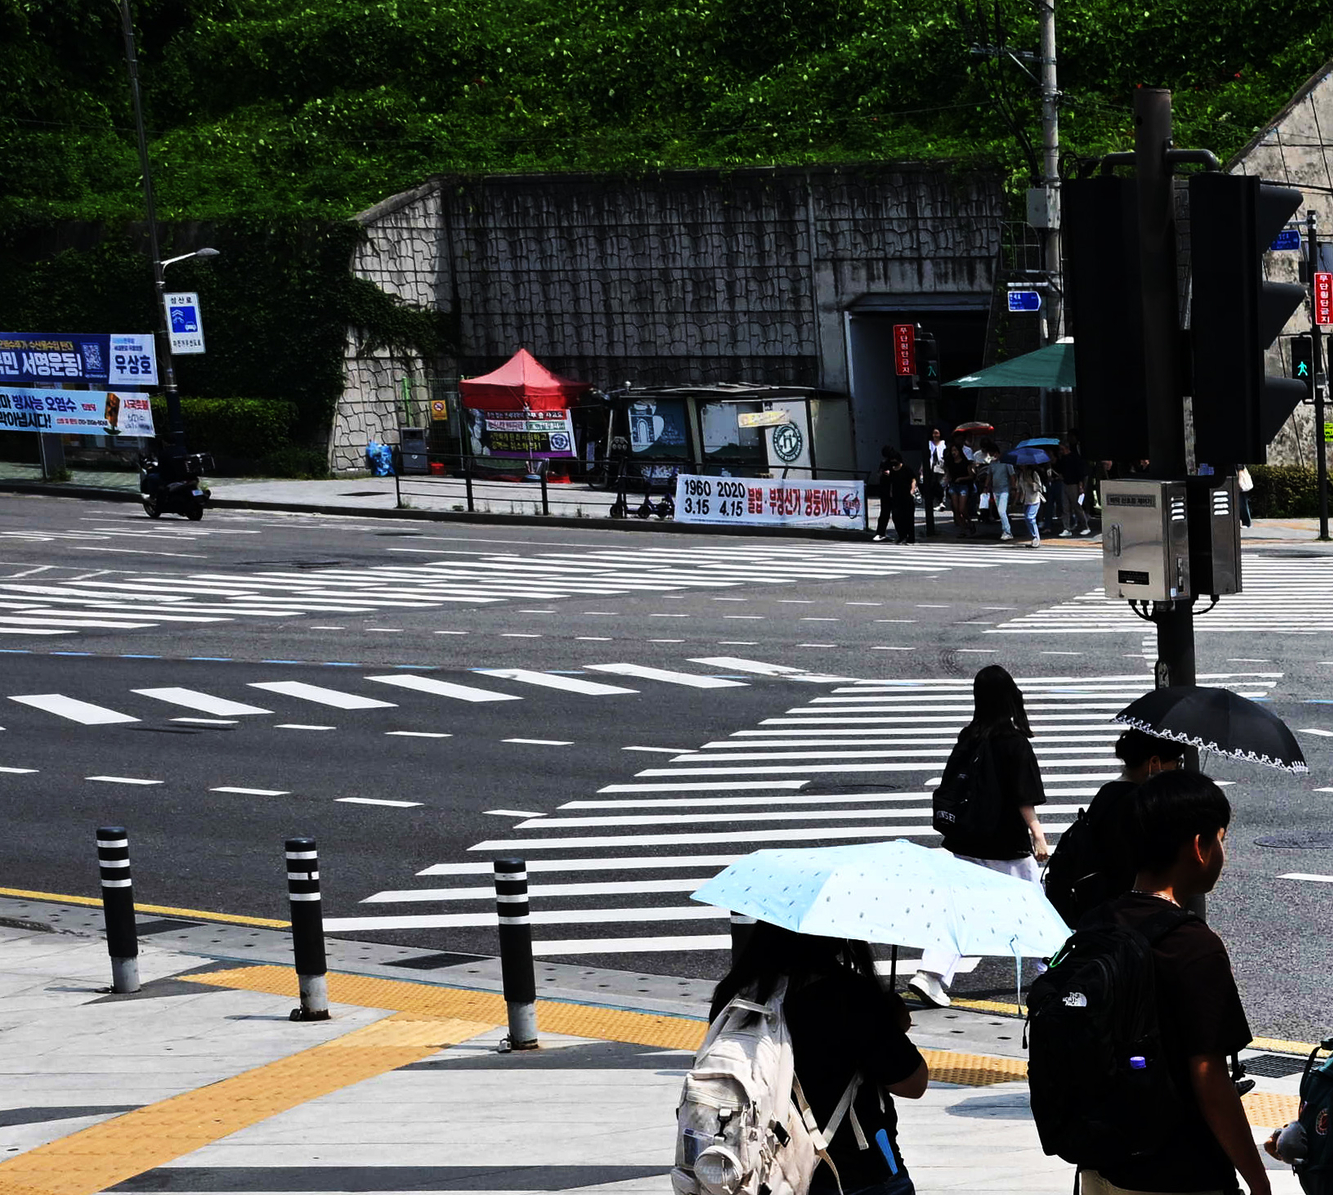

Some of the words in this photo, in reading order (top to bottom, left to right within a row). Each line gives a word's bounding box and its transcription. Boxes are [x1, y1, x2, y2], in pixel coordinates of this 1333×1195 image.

[22, 352, 83, 378] 서명운동!
[114, 354, 153, 375] 우상호
[11, 395, 44, 411] 방사능
[45, 397, 78, 413] 오염수
[684, 480, 711, 497] 1960
[717, 482, 745, 498] 2020
[684, 498, 710, 515] 3.15
[719, 501, 743, 517] 4.15
[804, 489, 841, 516] 쌍둥이다.
